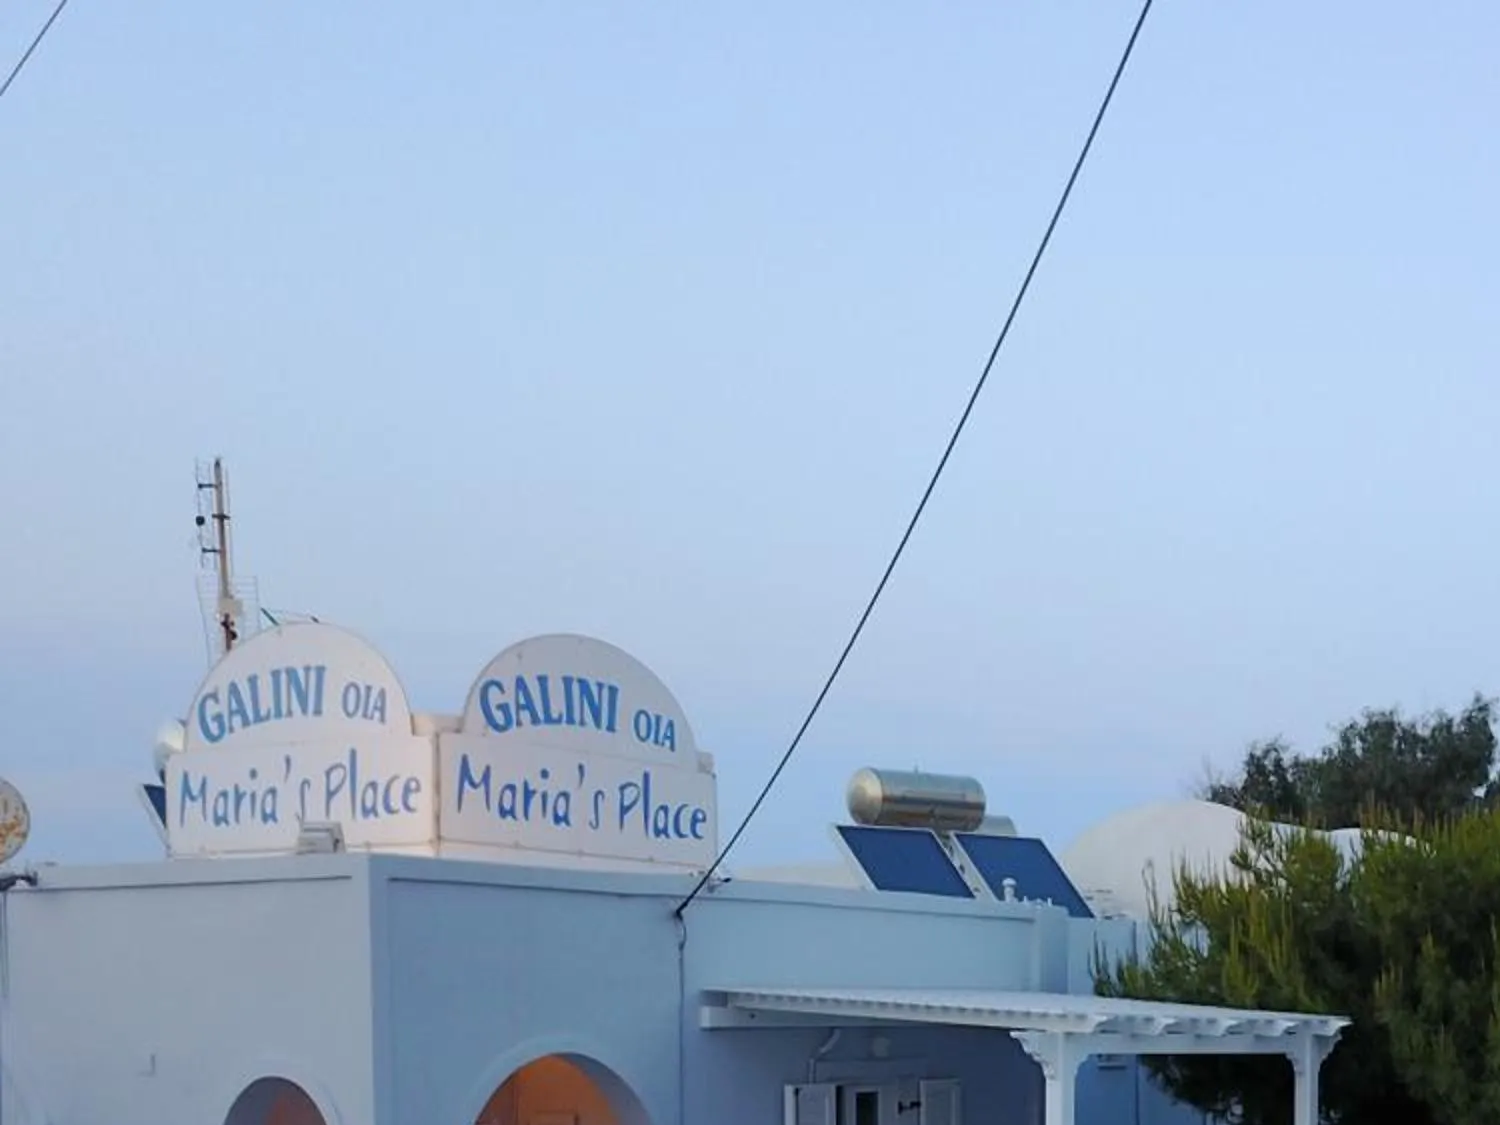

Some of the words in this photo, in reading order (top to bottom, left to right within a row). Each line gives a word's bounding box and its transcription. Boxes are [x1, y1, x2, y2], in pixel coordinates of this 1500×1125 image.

[198, 665, 327, 743] GALINI
[342, 681, 387, 725] OIA
[479, 674, 619, 733] GALINI
[633, 709, 676, 752] OIA
[179, 753, 312, 828] Maria's
[324, 747, 422, 821] Place
[457, 753, 605, 830] Maria's
[618, 770, 707, 840] Place
